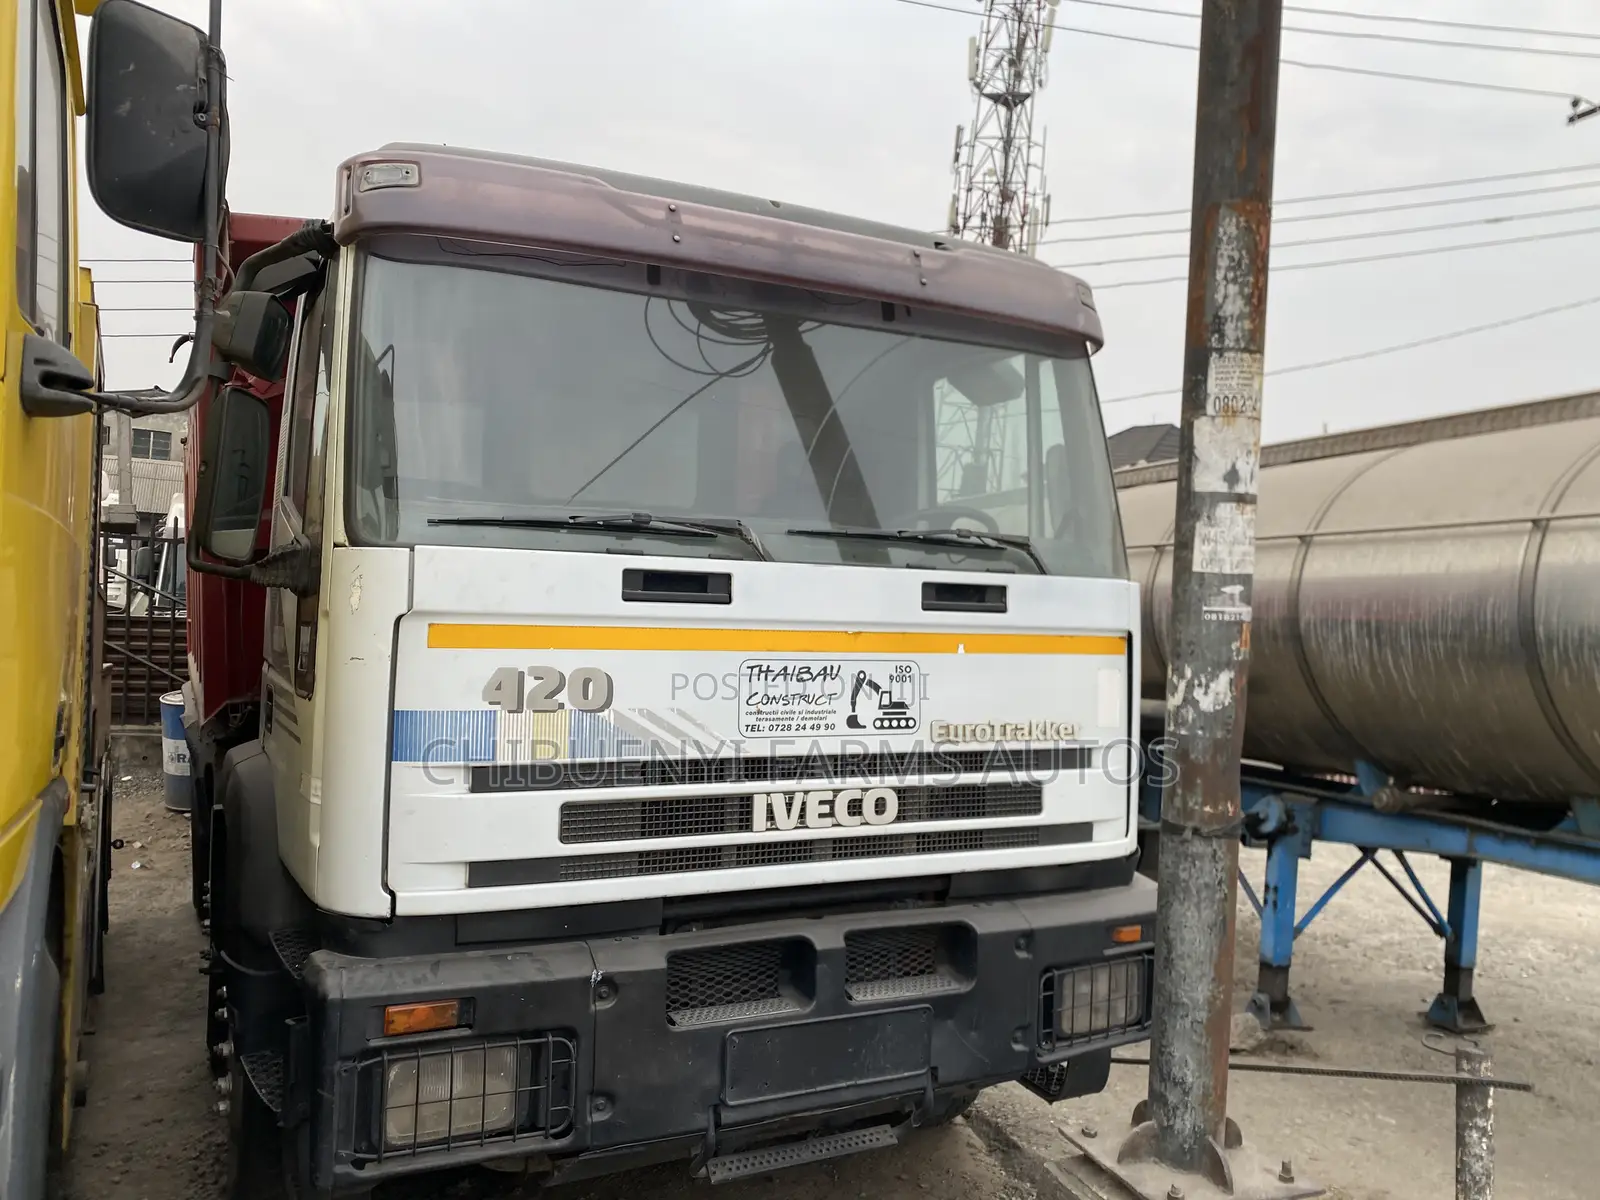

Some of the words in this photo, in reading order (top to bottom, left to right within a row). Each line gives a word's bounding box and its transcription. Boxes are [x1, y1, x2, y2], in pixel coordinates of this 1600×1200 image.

[746, 664, 841, 683] THAIBAU
[895, 665, 912, 674] ISO
[889, 674, 912, 683] 9001
[481, 665, 614, 714] 420
[746, 691, 838, 706] CONSTRUCT
[744, 724, 766, 732] TEL:
[768, 724, 792, 732] 0728
[795, 723, 807, 732] 24
[810, 723, 822, 731] 49
[824, 723, 836, 731] 90
[752, 787, 900, 832] IVECO
